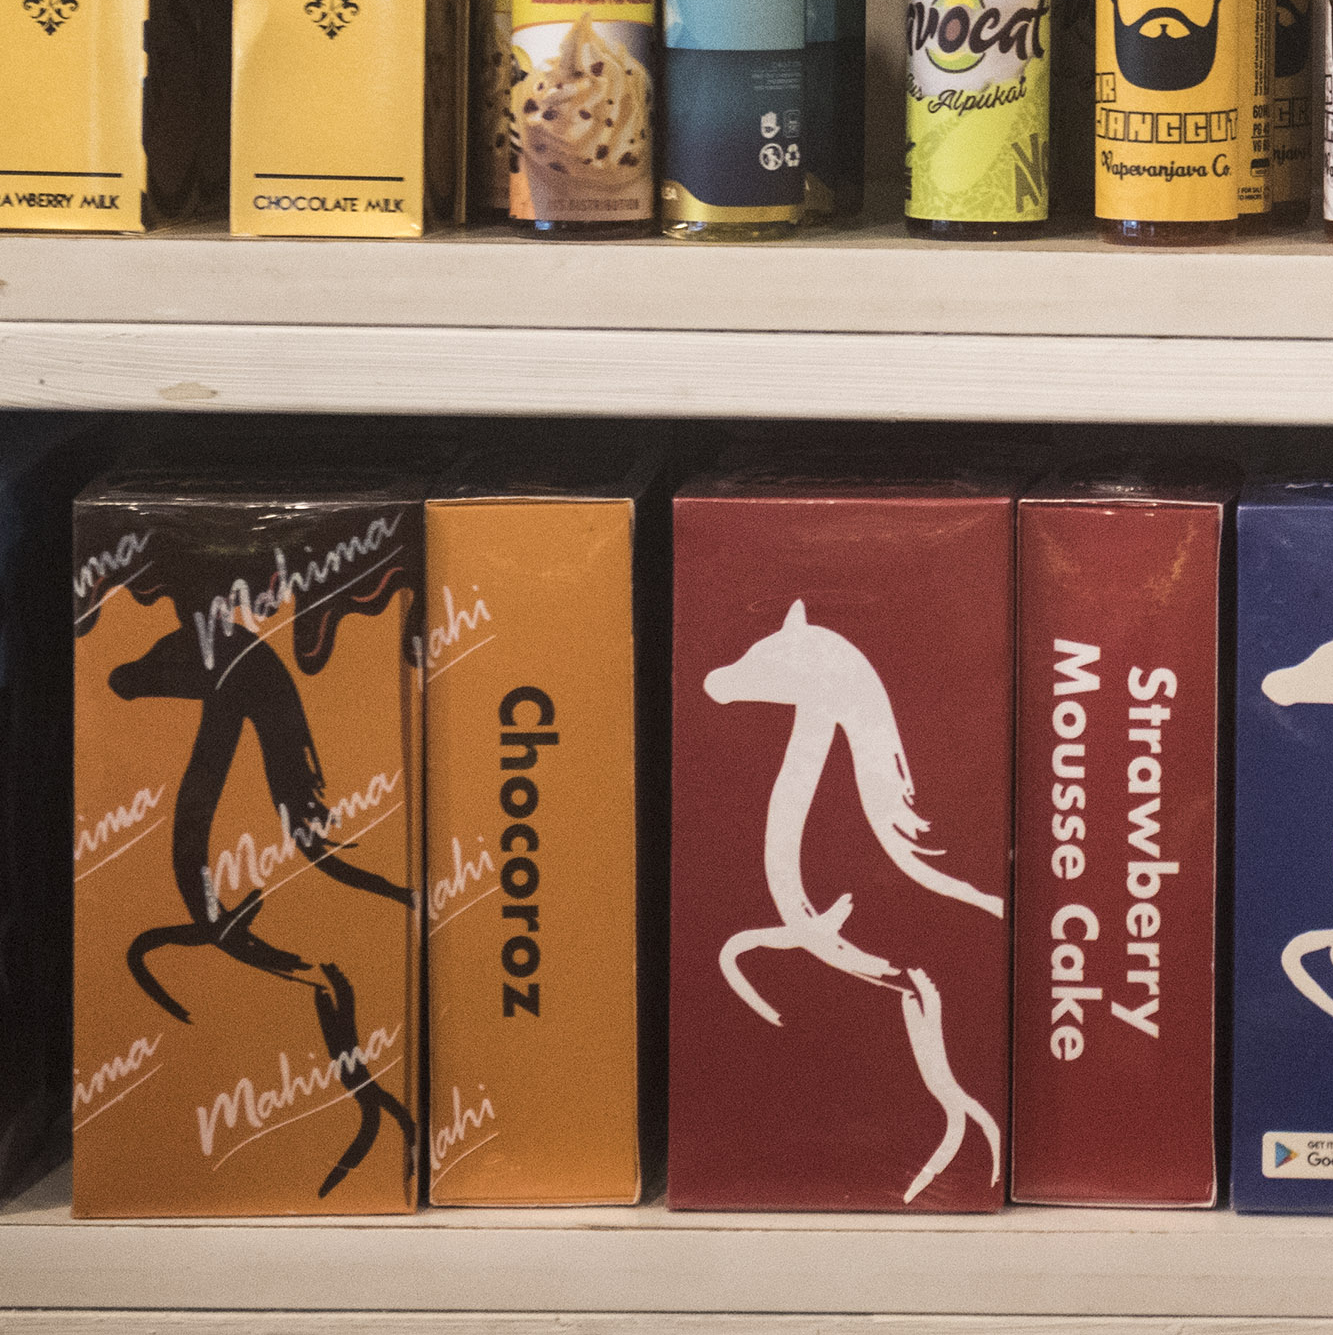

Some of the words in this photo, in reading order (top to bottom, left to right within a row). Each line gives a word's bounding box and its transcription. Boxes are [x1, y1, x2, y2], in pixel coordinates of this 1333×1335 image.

[79, 194, 120, 211] MILK
[252, 194, 359, 213] CHOCOLATE
[365, 197, 405, 214] MILK
[1101, 150, 1208, 182] Vapevanjava
[195, 512, 400, 671] Mahima
[1050, 638, 1102, 881] Mousse
[202, 769, 402, 923] Mahima
[498, 684, 560, 1019] Chocoroz
[1110, 666, 1180, 1039] Strawberry
[1049, 904, 1103, 1062] Cake
[196, 1023, 400, 1158] Mahima
[1307, 1141, 1326, 1150] GET
